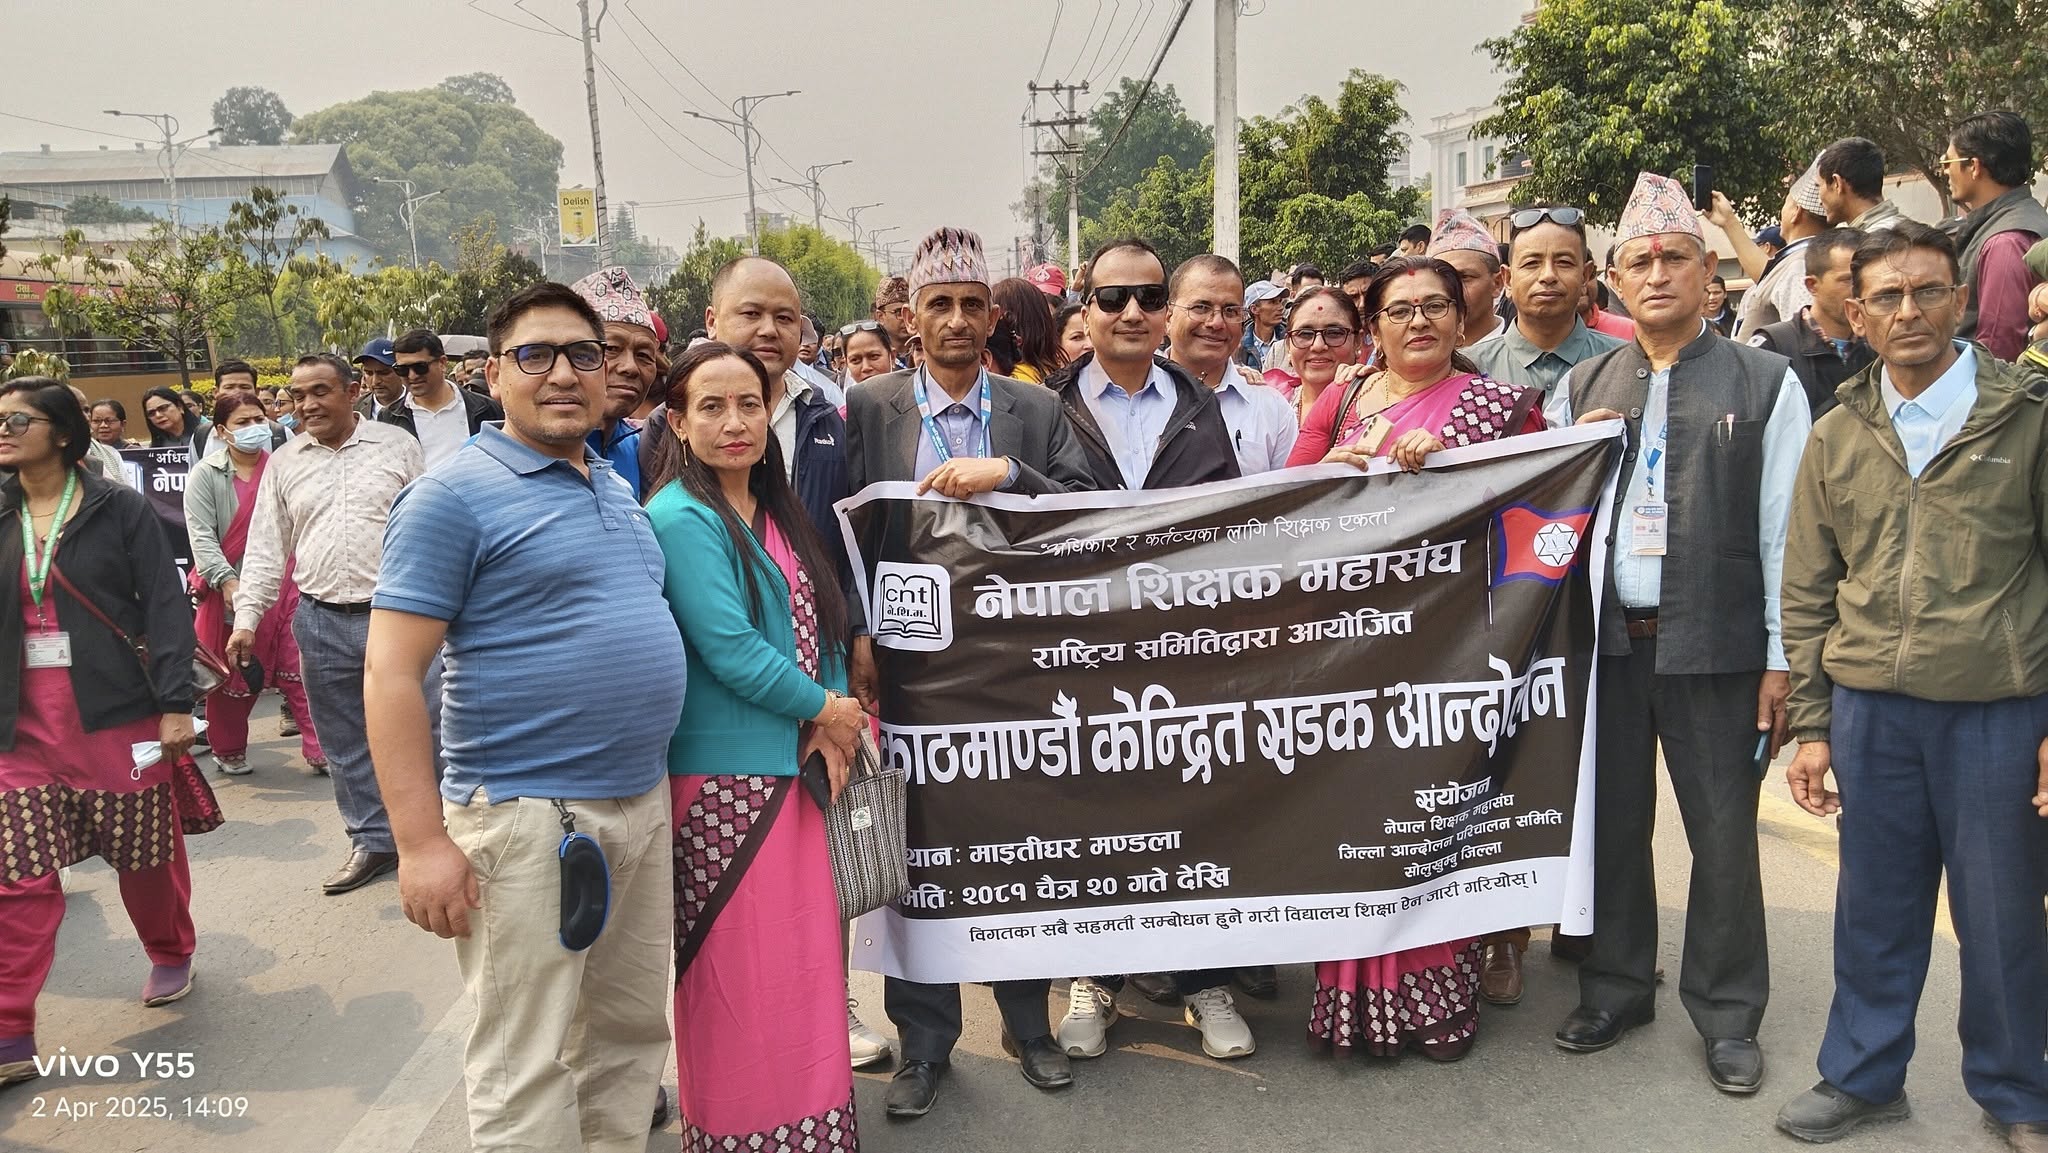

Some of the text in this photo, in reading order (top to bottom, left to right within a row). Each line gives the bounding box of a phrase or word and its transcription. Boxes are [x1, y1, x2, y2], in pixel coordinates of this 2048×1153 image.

[563, 197, 590, 205] Delish
[1126, 535, 1139, 551] र
[1226, 518, 1268, 544] लागि
[1274, 515, 1332, 539] शिक्षक
[885, 587, 928, 604] cnt
[973, 539, 1467, 620] नेपाल शिक्षक महासंघ
[1032, 607, 1414, 669] राष्ट्रिय समितिद्वारा आयोजित
[1088, 684, 1247, 784] केन्द्रित
[1253, 689, 1378, 775] सडक
[1384, 794, 1515, 835] नेपाल शिक्षक महासंघ
[1415, 776, 1492, 813] संयोजन
[968, 836, 1082, 865] माइतीघर
[1089, 831, 1182, 855] मण्डला
[1338, 809, 1563, 860] जिल्ला आन्दोलन परिचालन समिति
[1461, 841, 1502, 861] जिल्ला
[962, 883, 1027, 905] २०८१
[1035, 874, 1080, 900] चैत्र
[1086, 877, 1118, 896] २०
[1127, 867, 1168, 893] गते
[1176, 862, 1231, 890] देखि
[969, 926, 1037, 942] विगतका
[1040, 918, 1069, 936] सबै
[1073, 914, 1135, 935] सहमती
[1140, 911, 1211, 929] सम्बोधन
[1215, 908, 1243, 929] हुने
[1248, 906, 1281, 923] गरी
[1285, 905, 1350, 922] विद्यालय
[1355, 902, 1398, 918] शिक्षा
[1401, 893, 1424, 911] ऐन
[1426, 881, 1460, 903] जारी
